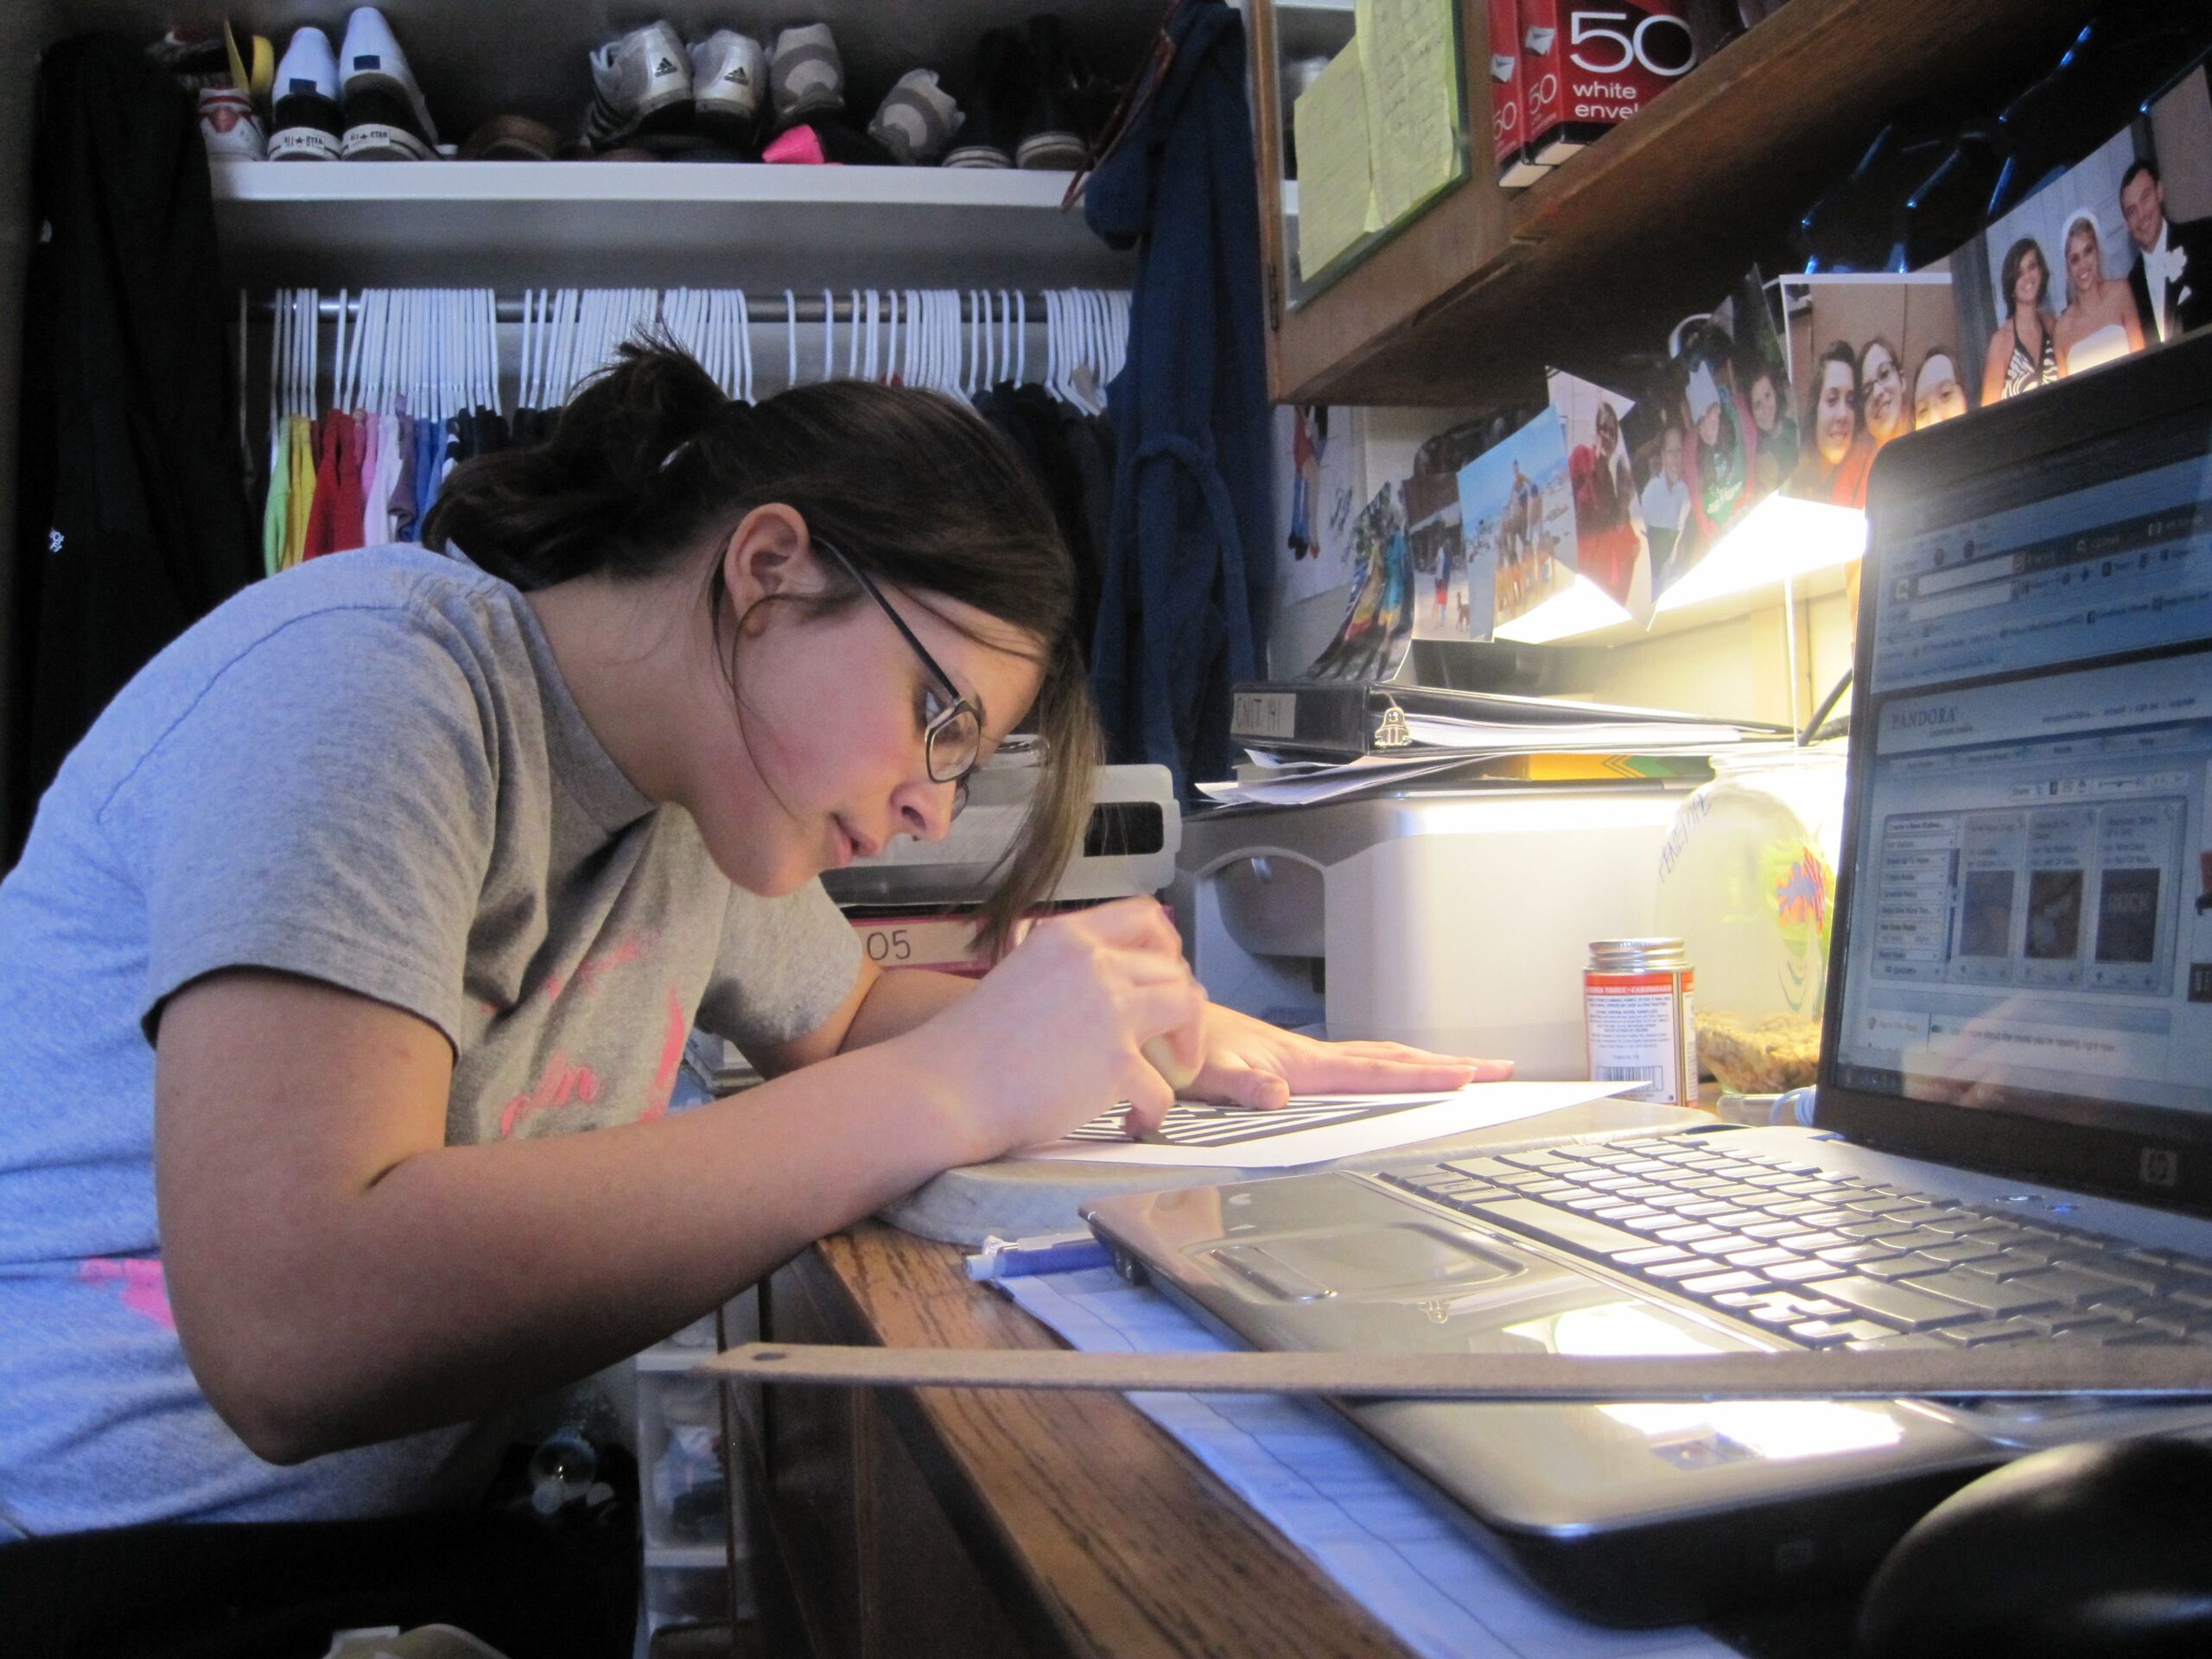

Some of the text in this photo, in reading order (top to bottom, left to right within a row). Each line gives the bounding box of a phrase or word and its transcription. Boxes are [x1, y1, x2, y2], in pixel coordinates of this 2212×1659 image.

[1569, 11, 1698, 76] 50
[1529, 73, 1557, 115] 50
[1573, 80, 1637, 99] white
[1493, 102, 1516, 140] 50
[1891, 707, 1955, 731] PANDORA
[867, 929, 912, 961] 05
